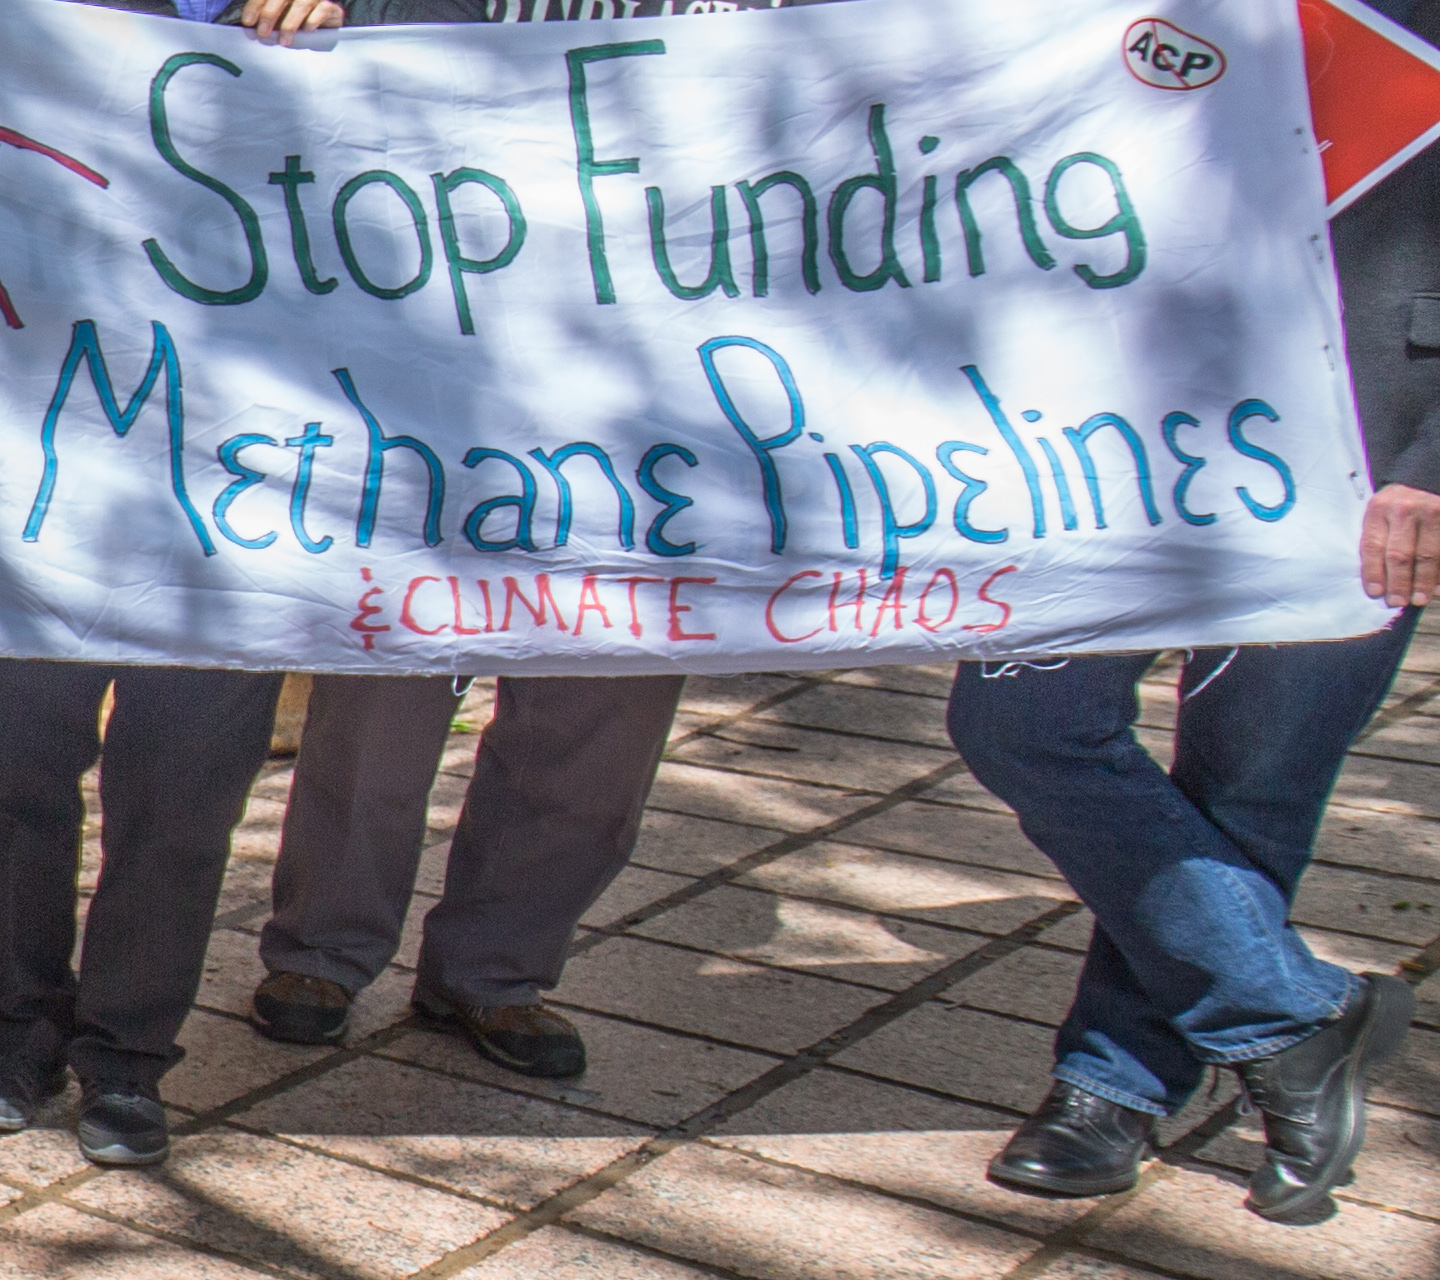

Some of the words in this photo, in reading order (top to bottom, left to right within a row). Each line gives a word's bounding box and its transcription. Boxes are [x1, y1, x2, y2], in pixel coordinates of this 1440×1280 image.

[1127, 30, 1215, 78] ACP
[141, 50, 527, 335] Stop
[565, 38, 1148, 306] Funding
[697, 334, 1298, 581] Pipelines
[398, 572, 717, 643] CLIMATE
[765, 564, 1020, 644] CHAOS
